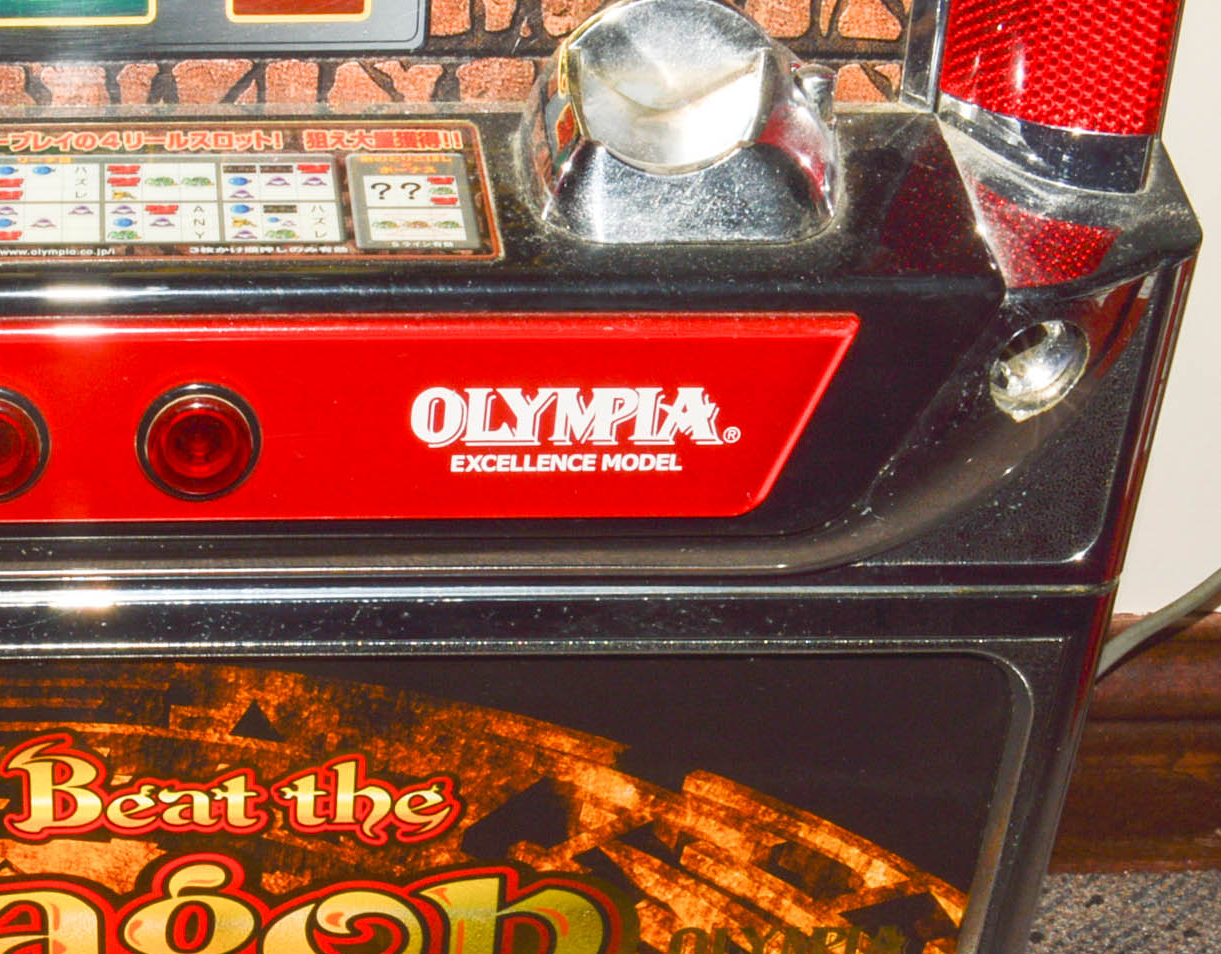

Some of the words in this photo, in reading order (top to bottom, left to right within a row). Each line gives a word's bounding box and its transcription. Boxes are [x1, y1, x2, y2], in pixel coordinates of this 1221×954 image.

[411, 387, 724, 448] OLYMPIA
[450, 454, 596, 473] EXCELLENCE
[601, 454, 683, 472] MODEL
[3, 736, 268, 838] Beat
[275, 756, 459, 843] the
